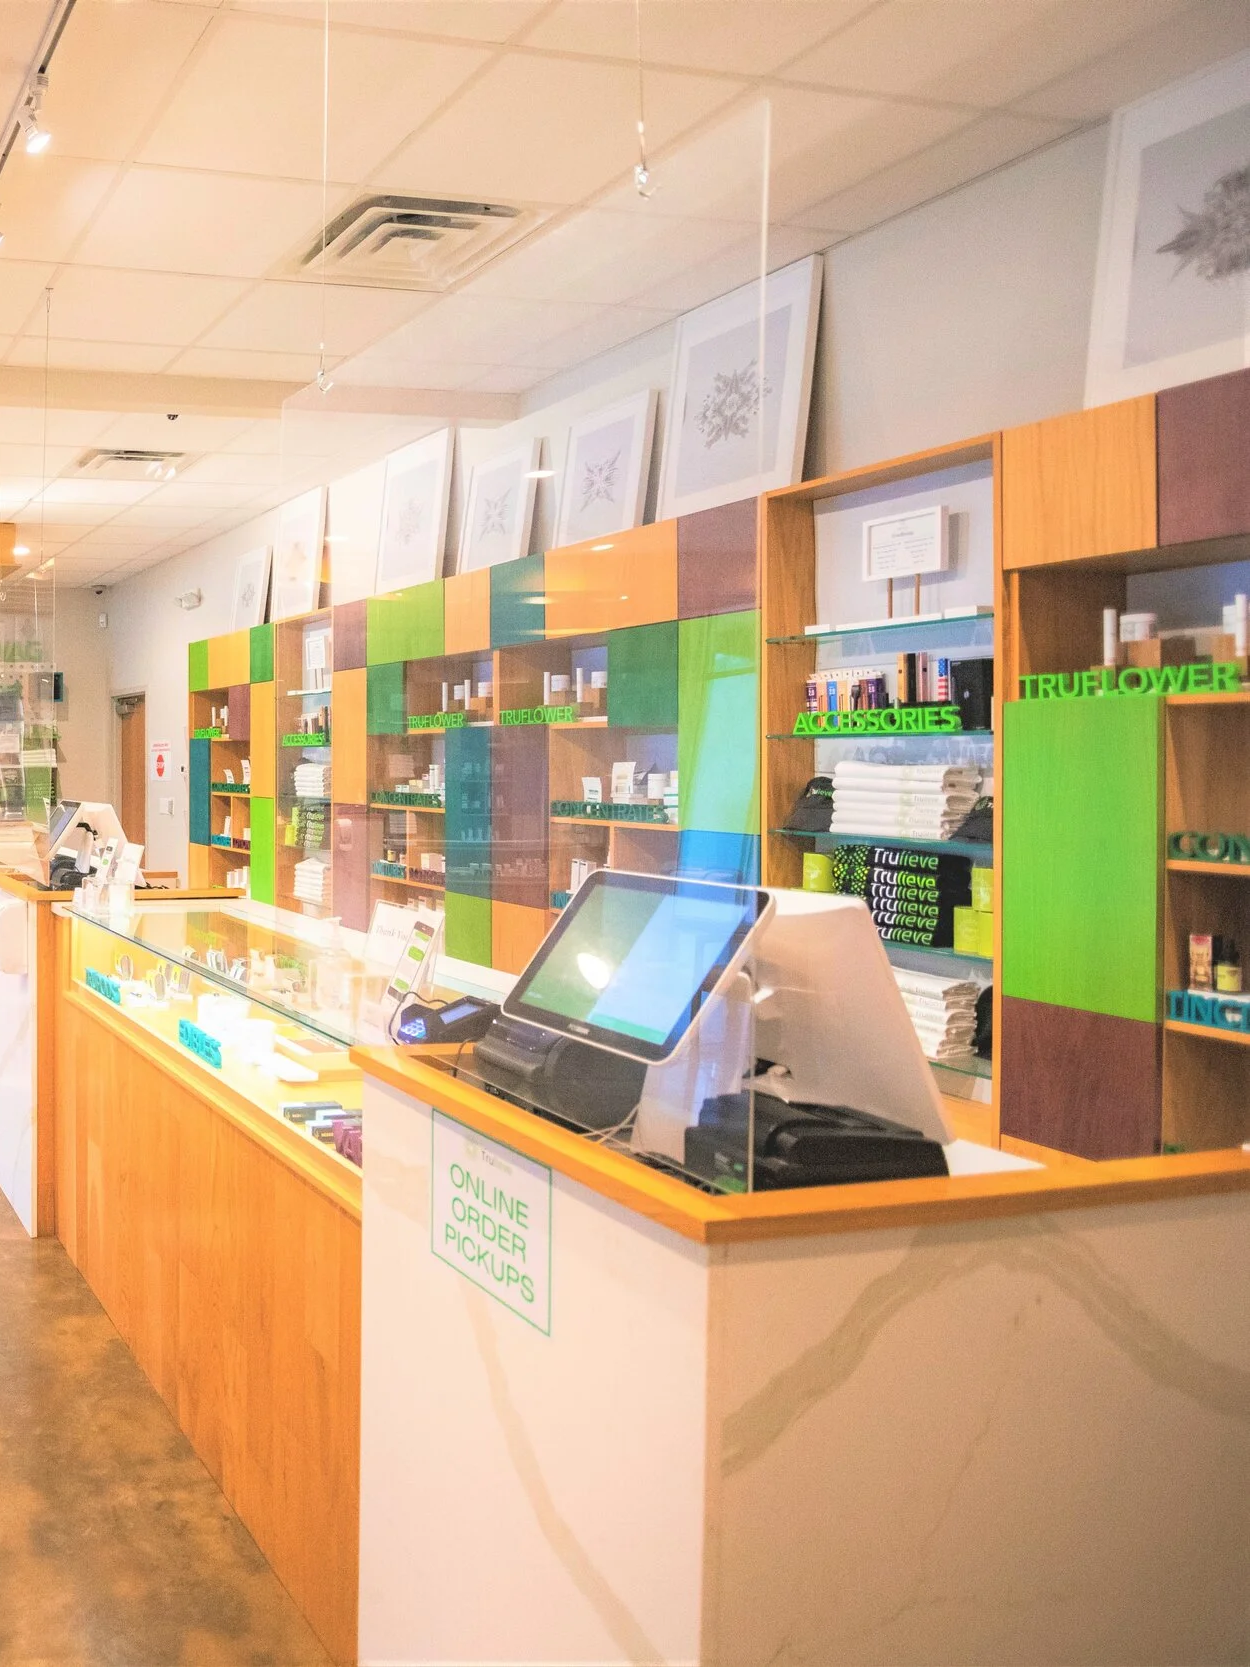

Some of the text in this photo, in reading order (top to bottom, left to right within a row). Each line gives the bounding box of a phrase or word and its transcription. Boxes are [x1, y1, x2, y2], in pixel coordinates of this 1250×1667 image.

[1019, 662, 1240, 699] TRUFLOWER
[408, 712, 466, 729] TRUFLOWER
[500, 706, 575, 725] TRUFLOWER
[793, 706, 961, 734] ACCESSORIES
[371, 791, 442, 809] CONCENTRATES
[551, 800, 669, 824] CONCENTRATES
[873, 847, 939, 870] Trulieve
[873, 867, 936, 889] Trulieve
[870, 882, 939, 903] Trulieve
[872, 897, 939, 918] Trulieve
[871, 910, 938, 931] Trulieve
[449, 1163, 529, 1230] ONLINE
[451, 1196, 527, 1264] ORDER
[445, 1223, 535, 1304] PICKUPS
